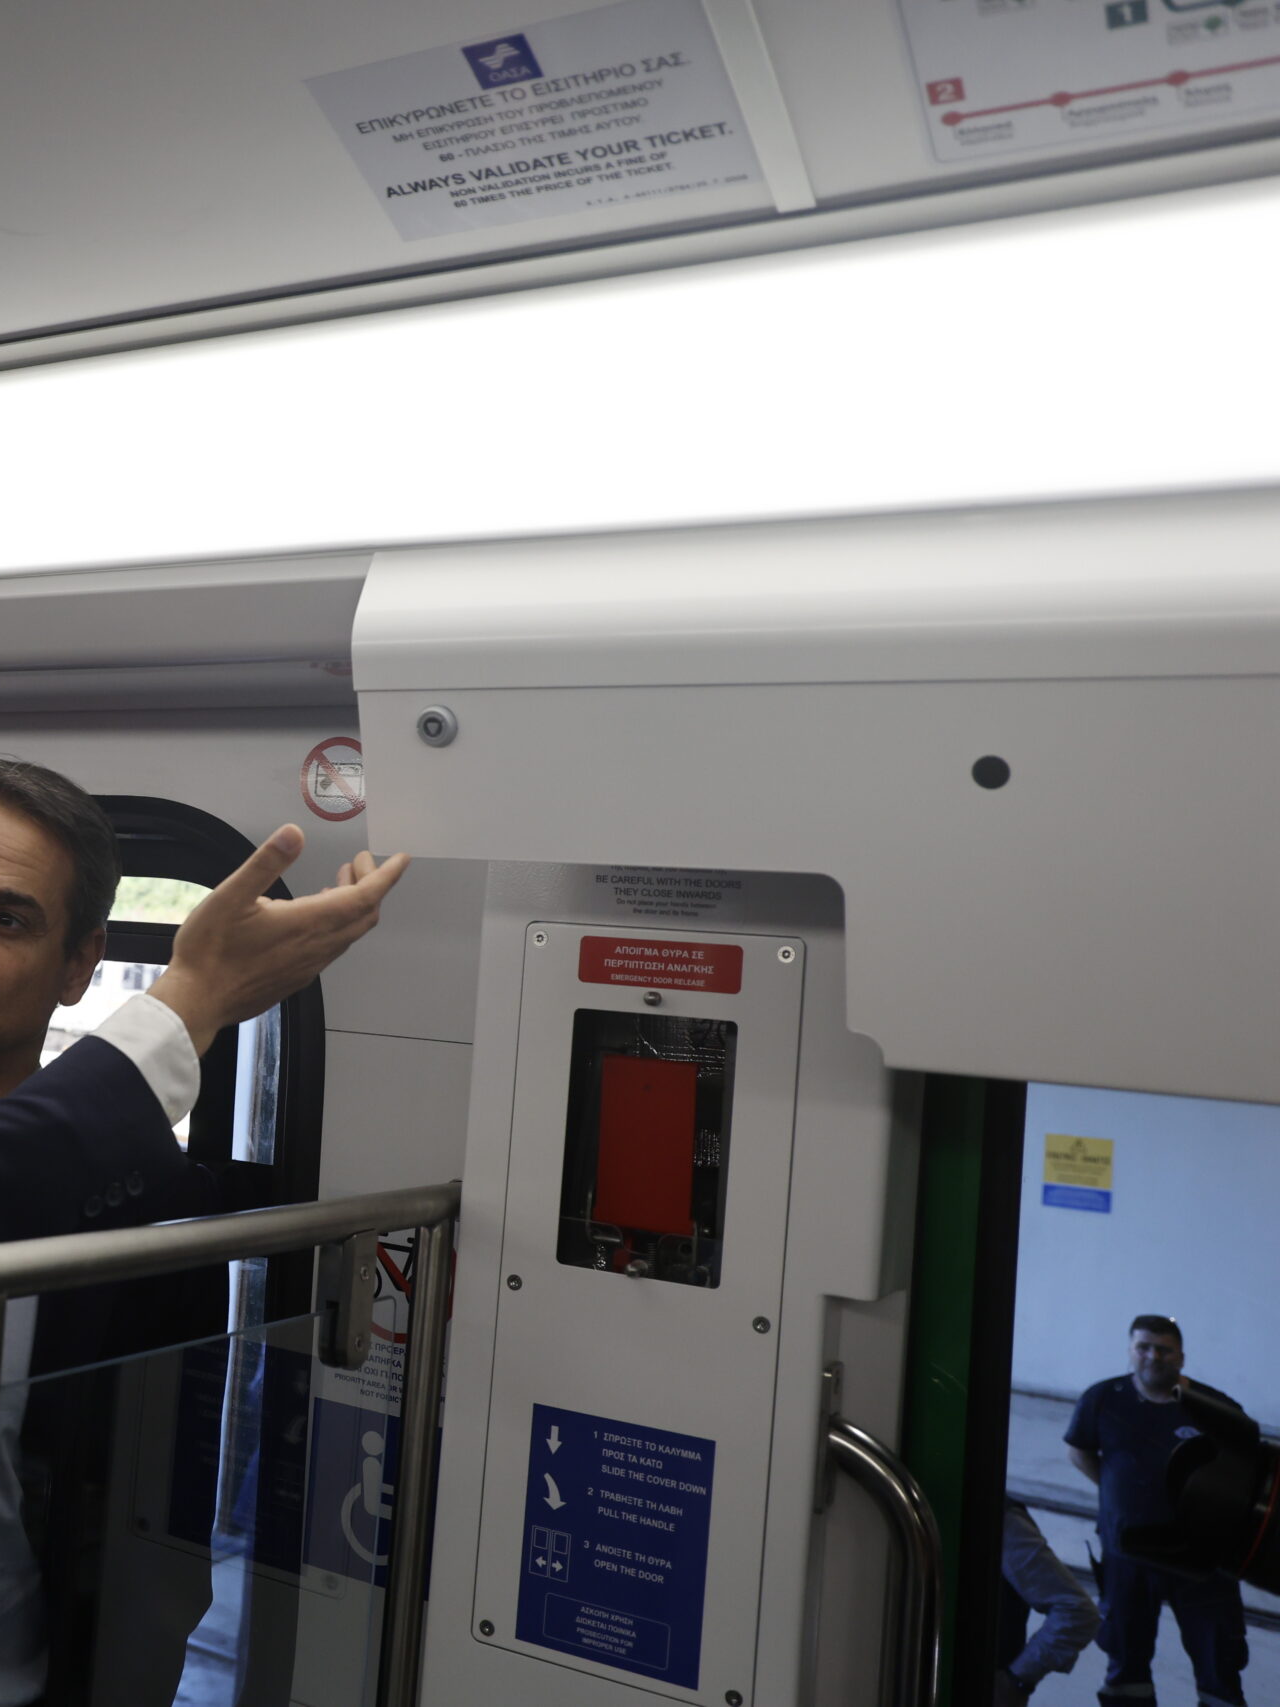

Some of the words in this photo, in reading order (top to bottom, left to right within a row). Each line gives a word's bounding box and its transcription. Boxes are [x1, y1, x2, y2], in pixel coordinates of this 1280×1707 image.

[489, 65, 531, 82] ΟΑΣΑ
[356, 95, 494, 134] ΕΠΙΚΥΡΩΝΕΤΕ
[496, 87, 526, 104] ΤΟ
[531, 63, 636, 97] ΕΙΣΙΤΗΡΙΟ
[641, 51, 692, 73] ΣΑΣ.
[936, 82, 956, 101] 2
[392, 132, 414, 143] ΜΗ
[416, 115, 493, 138] ΕΠΙΚΥΡΩΣΗ
[495, 107, 525, 121] ΤΟΥ
[528, 78, 664, 114] ΠΡΟΒΛΕΠΟΜΕΝΟΥ
[422, 129, 497, 151] ΕΙΣΙΤΗΡΙΟΥ
[570, 97, 649, 120] ΠΡΟΣΤΙΜΟ
[520, 134, 546, 146] ΤΗΣ
[550, 124, 592, 141] ΤΙΜΗΣ
[386, 173, 466, 198] ALWAYS
[469, 152, 572, 181] VALIDATE
[575, 139, 642, 162] YOUR
[644, 121, 734, 148] TICKET.
[450, 187, 476, 198] NON
[481, 172, 550, 192] VALIDATION
[554, 161, 601, 178] INCURS
[606, 161, 615, 170] A
[617, 155, 646, 167] FINE
[649, 151, 668, 161] OF
[454, 198, 468, 208] 60
[471, 192, 506, 204] TIMES
[509, 186, 533, 198] THE
[536, 181, 573, 193] PRICE
[577, 176, 593, 186] OF
[599, 171, 623, 182] THE
[595, 874, 609, 884] BE
[610, 875, 654, 886] CAREFUL
[656, 877, 681, 887] WITH
[684, 878, 703, 888] THE
[705, 879, 742, 889] DOORS
[613, 886, 638, 897] THEY
[640, 888, 673, 898] CLOSE
[676, 890, 722, 900] INWARDS
[661, 948, 689, 958] ΘΥΡΑ
[691, 950, 704, 960] ΣΕ
[610, 973, 652, 983] EMERGENCY
[653, 976, 673, 985] DOOR
[674, 978, 706, 987] RELEASE
[667, 963, 714, 975] ΑΝΑΓΚΗΣ
[593, 1430, 598, 1439] 1
[603, 1432, 642, 1449] ΣΠΡΩΞΤΕ
[645, 1441, 657, 1452] ΤΟ
[658, 1444, 702, 1461] ΚΑΛΥΜΜΑ
[602, 1448, 625, 1461] ΠΡΟΣ
[627, 1453, 638, 1464] ΤΑ
[639, 1456, 663, 1470] ΚΑΤΩ
[601, 1464, 626, 1478] SLIDE
[628, 1470, 645, 1482] THE
[646, 1474, 677, 1489] COVER
[679, 1481, 706, 1495] DOWN
[587, 1487, 594, 1496] 2
[600, 1489, 643, 1508] ΤΡΑΒΗΞΤΕ
[646, 1499, 657, 1510] ΤΗ
[658, 1503, 683, 1517] ΛΑΒΗ
[598, 1506, 620, 1519] PULL
[621, 1511, 638, 1524] THE
[639, 1515, 676, 1532] HANDLE
[583, 1540, 590, 1549] 3
[595, 1543, 632, 1560] ΑΝΟΙΞΤΕ
[635, 1552, 646, 1562] ΤΗ
[647, 1555, 672, 1570] ΘΥΡΑ
[594, 1558, 618, 1573] OPEN
[619, 1564, 637, 1577] THE
[638, 1570, 665, 1584] DOOR
